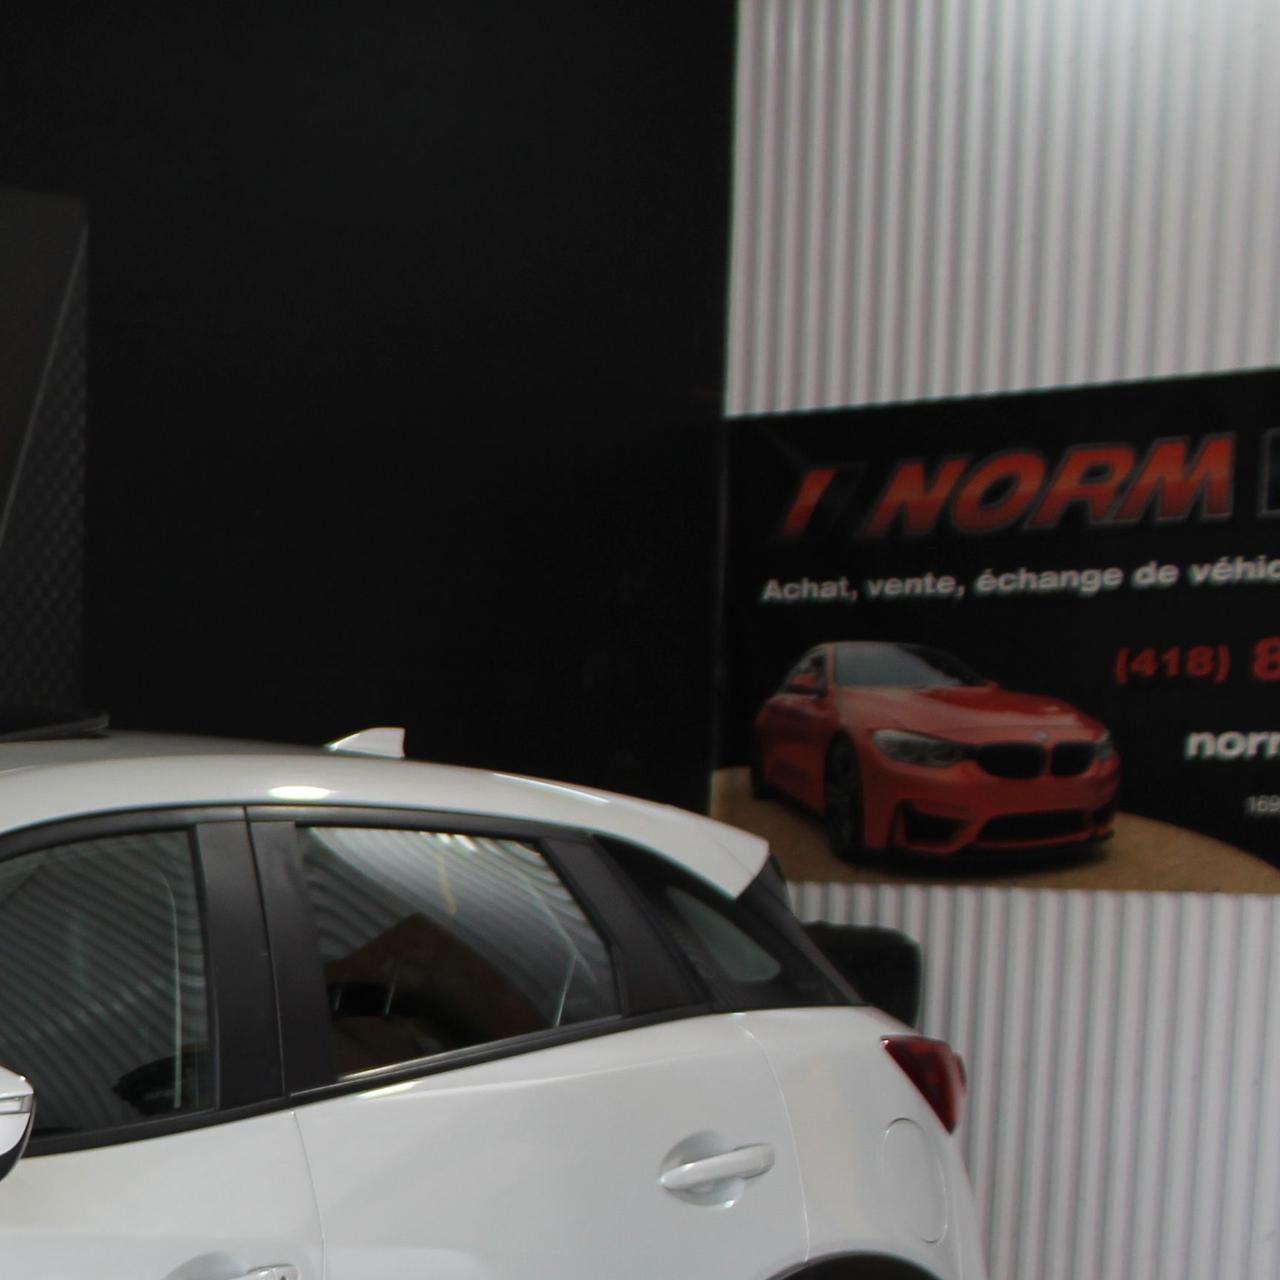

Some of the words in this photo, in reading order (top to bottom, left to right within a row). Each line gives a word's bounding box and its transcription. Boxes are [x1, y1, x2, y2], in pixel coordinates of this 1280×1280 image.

[858, 428, 1280, 537] NORM
[762, 576, 858, 601] Achat,
[868, 571, 965, 598] vente,
[975, 567, 1124, 596] échange
[1132, 561, 1180, 588] de
[1115, 646, 1231, 684] (418)
